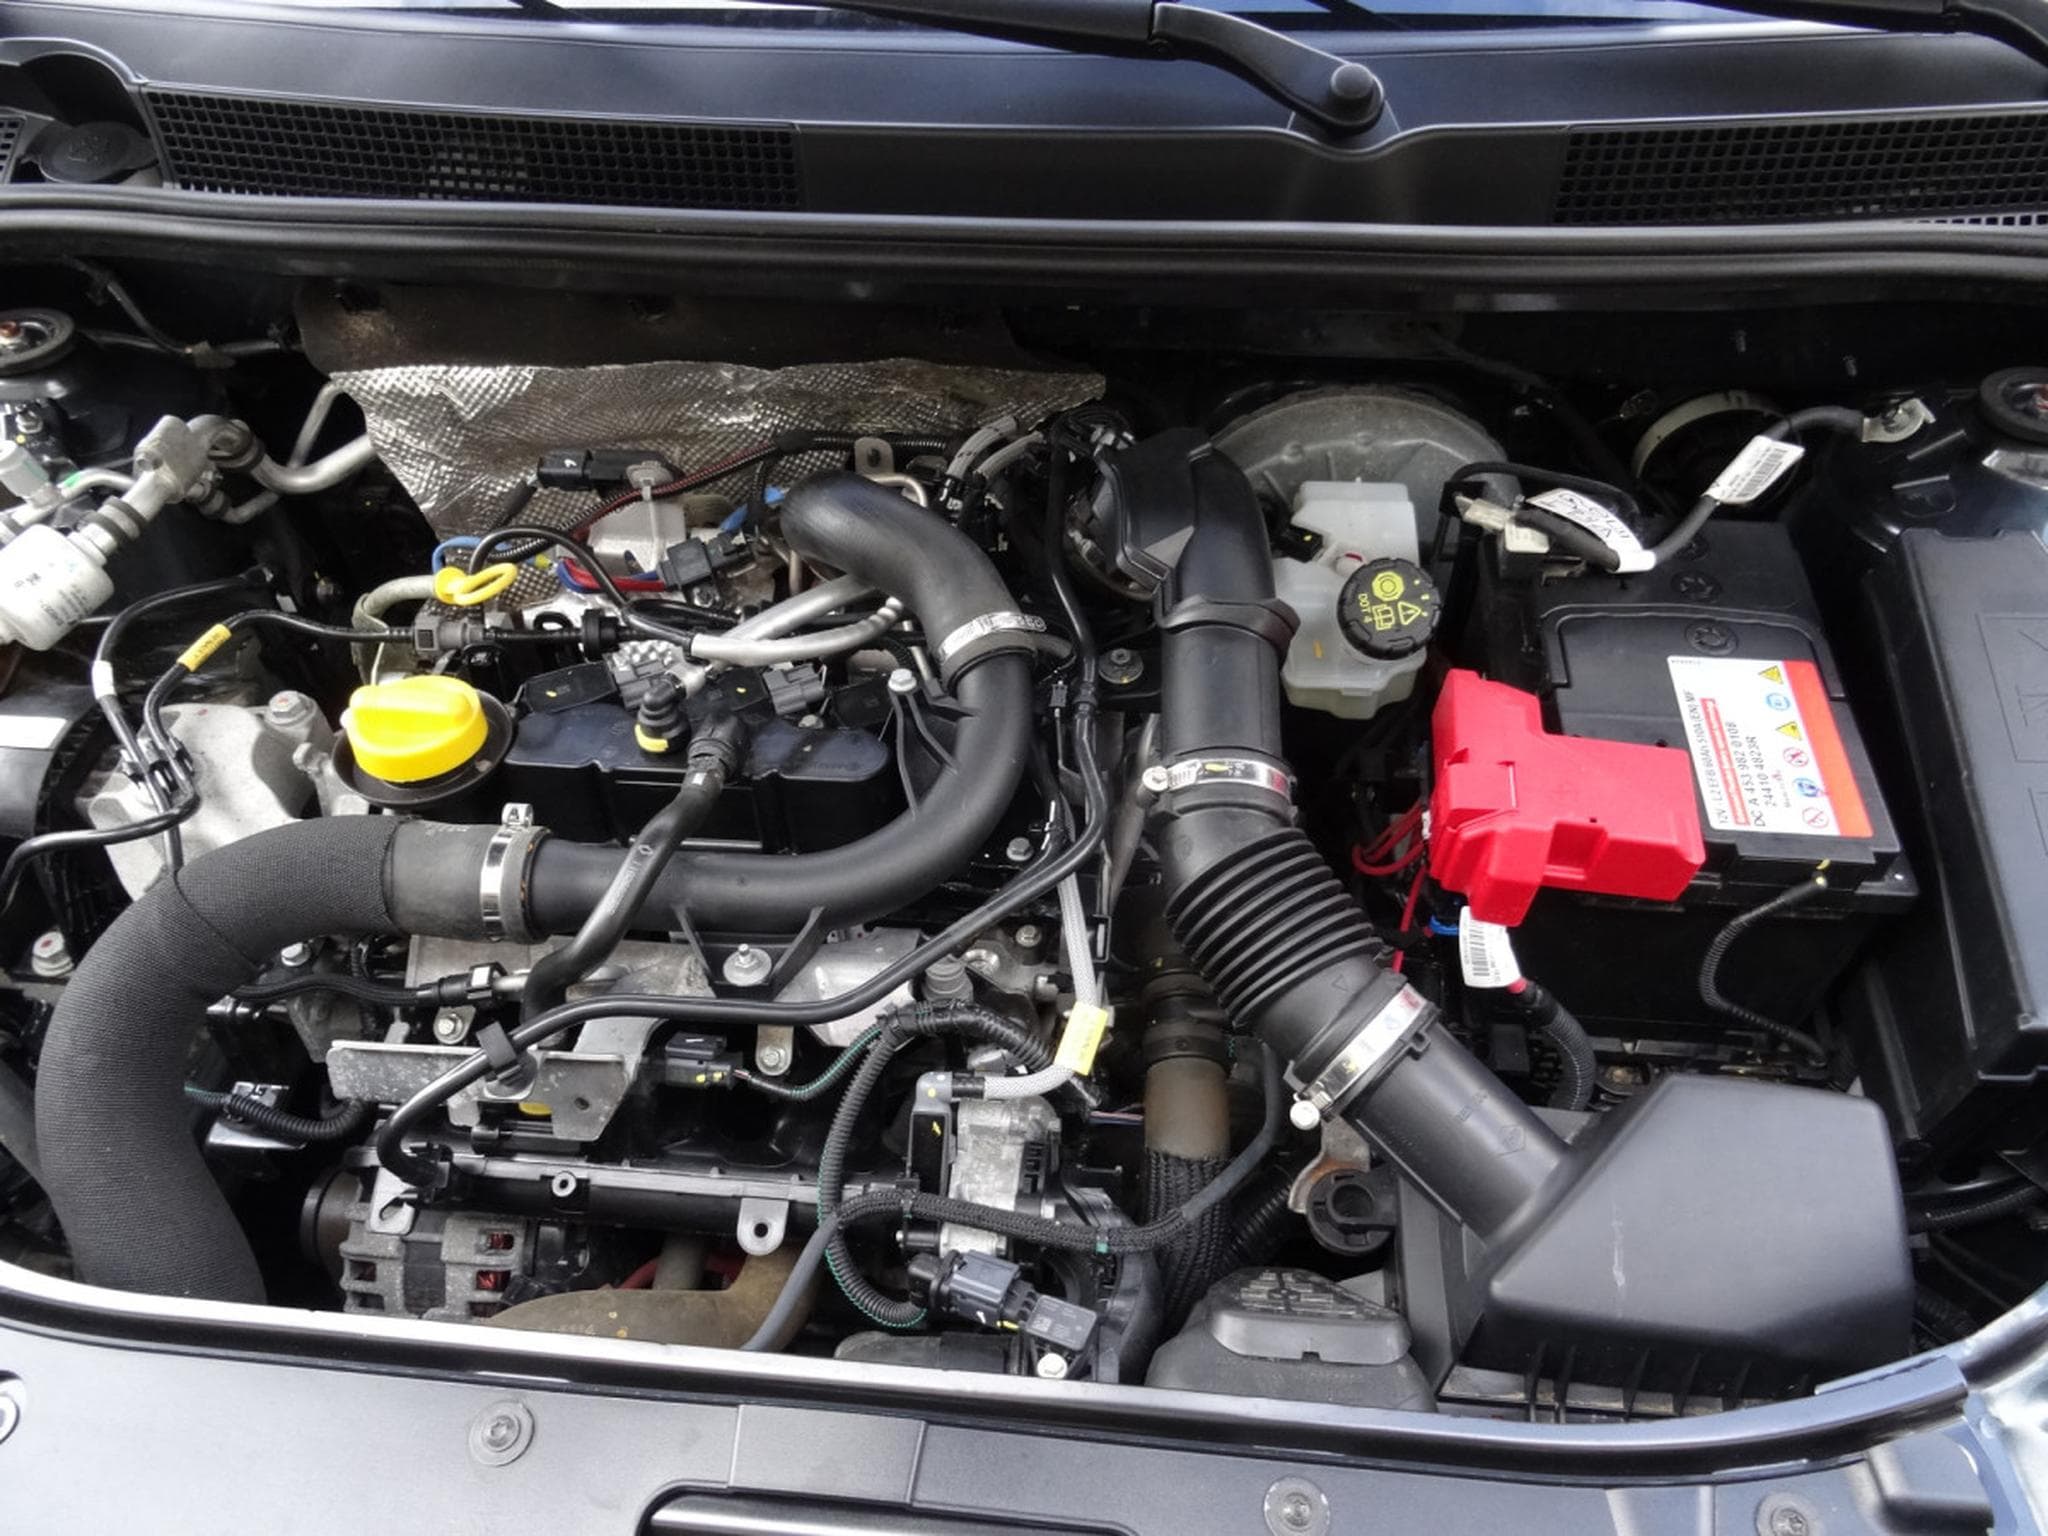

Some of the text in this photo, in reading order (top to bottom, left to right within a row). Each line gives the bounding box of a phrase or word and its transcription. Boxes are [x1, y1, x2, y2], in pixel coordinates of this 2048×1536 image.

[1358, 593, 1373, 624] DOT 4
[1747, 797, 1759, 806] A
[1751, 810, 1766, 826] DC
